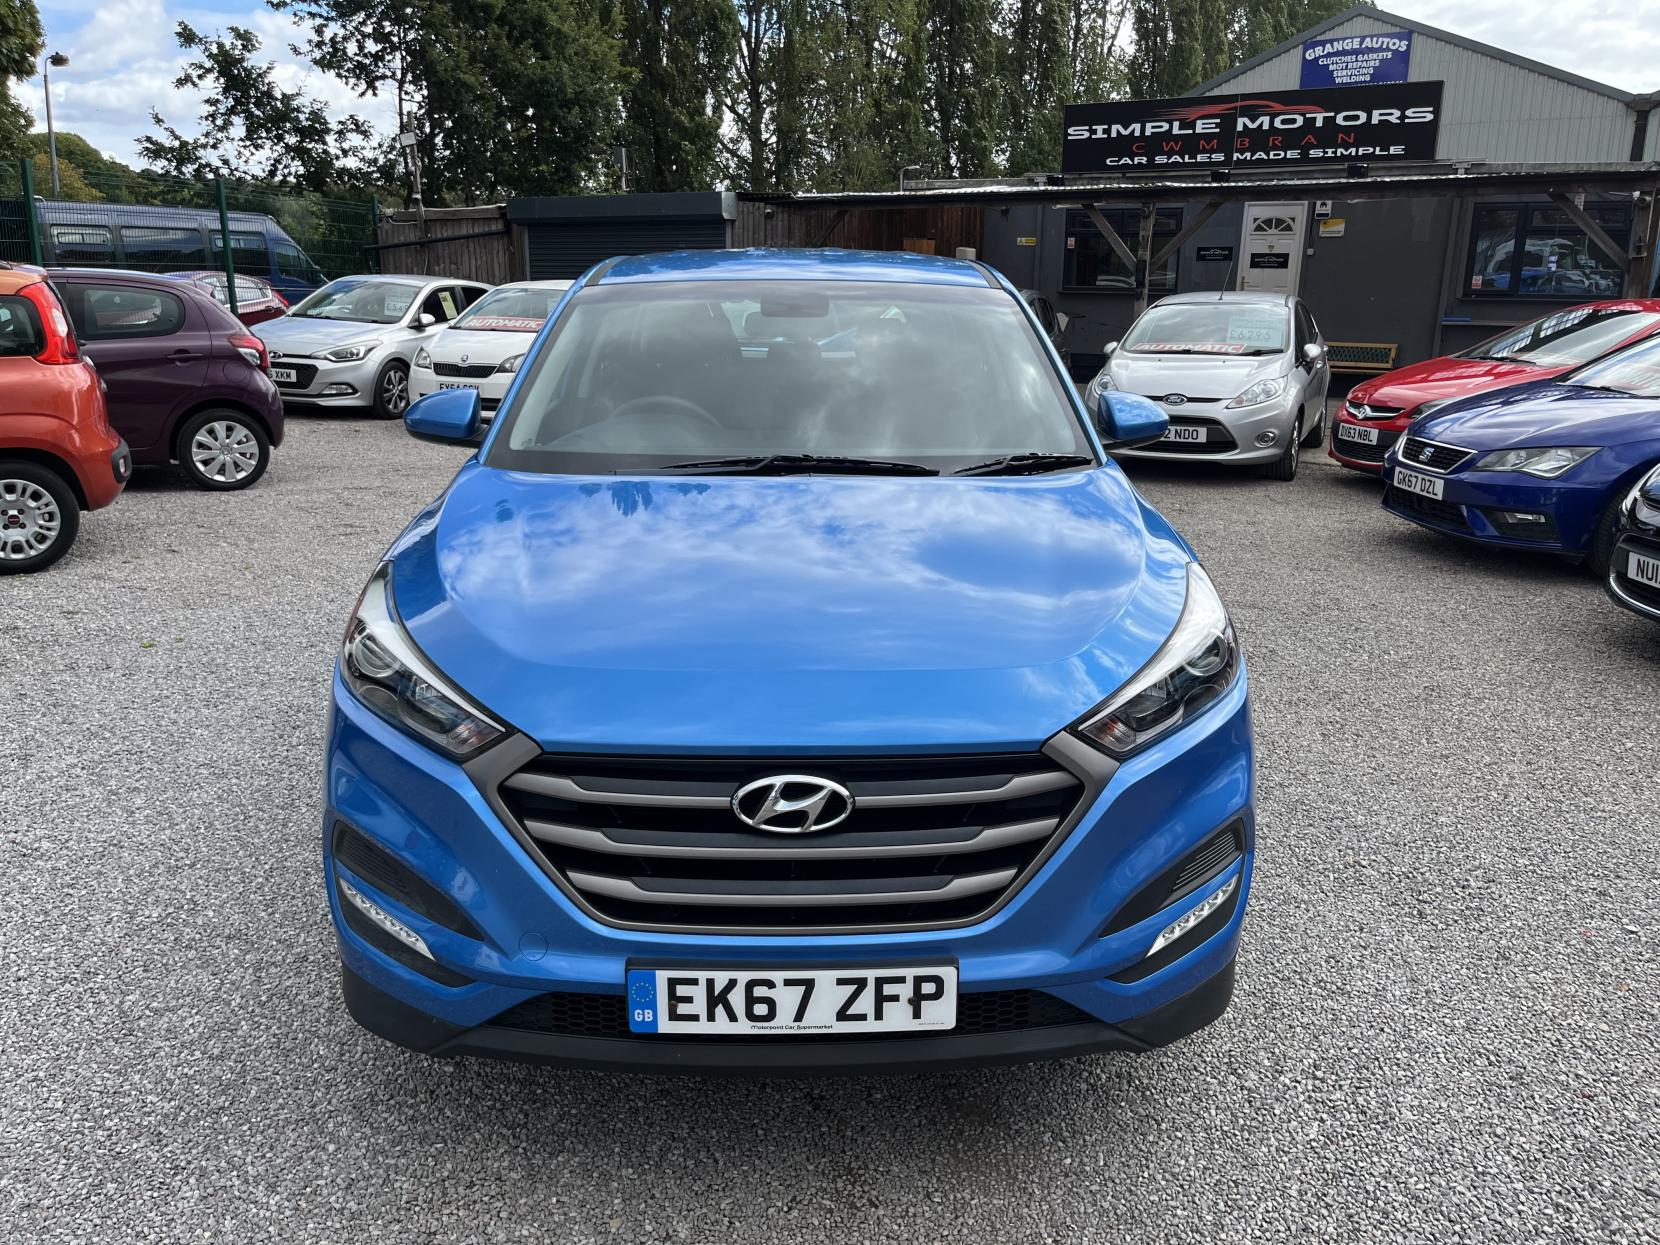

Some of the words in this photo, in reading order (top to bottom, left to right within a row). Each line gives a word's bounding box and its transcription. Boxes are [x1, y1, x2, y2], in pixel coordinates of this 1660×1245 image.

[1305, 38, 1360, 60] GRANGE
[1361, 37, 1408, 52] AUTOS
[1318, 55, 1356, 65] CLUTCHES
[1357, 51, 1393, 61] GASKETS
[1328, 63, 1347, 71] MOT
[1347, 60, 1380, 69] REPAIRS
[1333, 67, 1374, 77] SERVICING
[1335, 74, 1371, 84] WELDING
[1067, 118, 1221, 140] SIMPLE
[1236, 106, 1434, 132] MOTORS
[1132, 132, 1355, 153] CWMBRAN
[1106, 156, 1148, 166] CAR
[1154, 153, 1225, 164] SALES
[1233, 150, 1301, 161] MADE
[1308, 145, 1406, 158] SIMPLE
[466, 319, 544, 329] AUTOMATIC
[1136, 343, 1239, 353] AUTOMATIC
[275, 371, 292, 380] XKM
[1174, 428, 1199, 441] NDO
[1357, 428, 1373, 442] NBL
[1397, 470, 1419, 487] GK67
[1420, 477, 1438, 497] DZL
[667, 977, 816, 1023] EK67
[835, 974, 945, 1022] ZFP
[634, 1009, 654, 1022] GB
